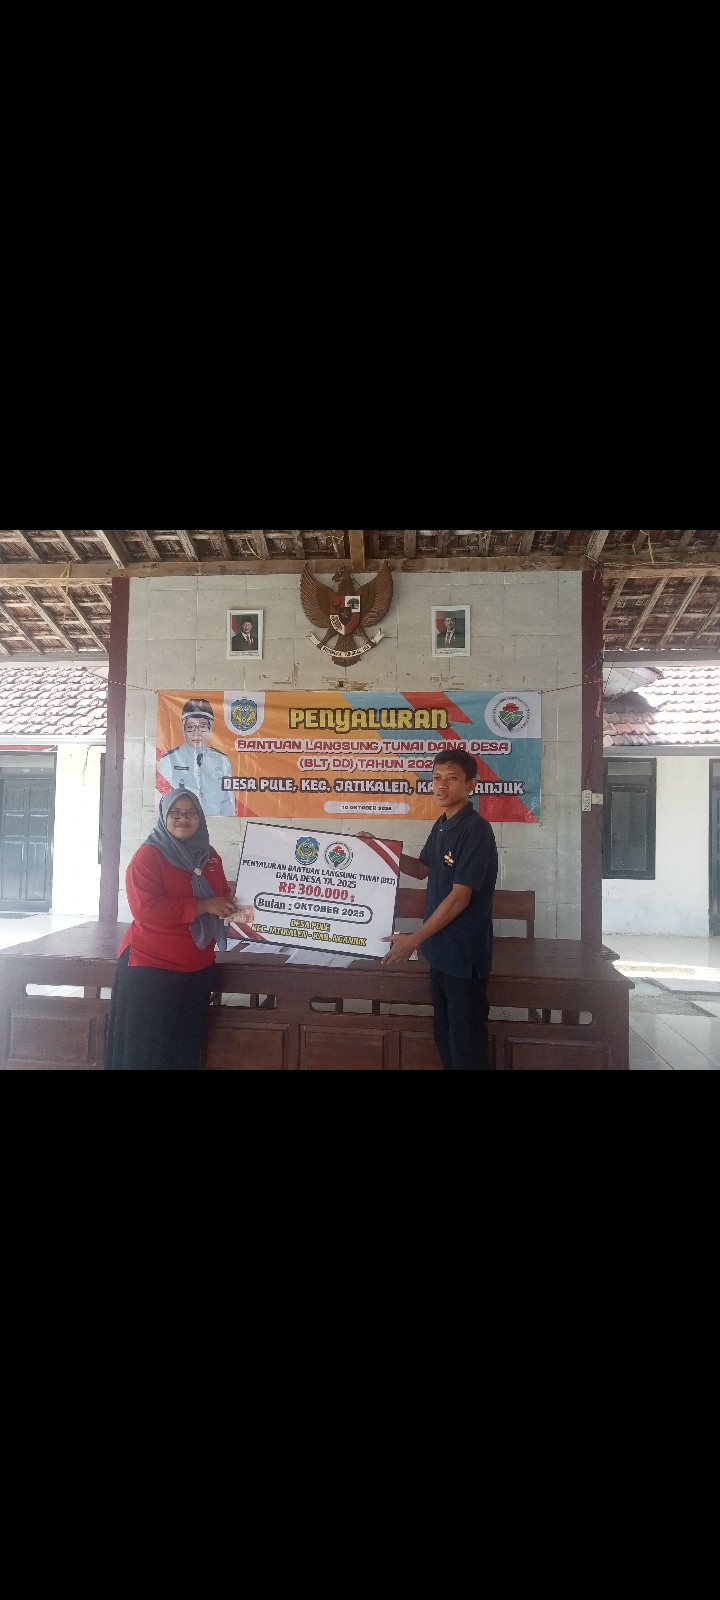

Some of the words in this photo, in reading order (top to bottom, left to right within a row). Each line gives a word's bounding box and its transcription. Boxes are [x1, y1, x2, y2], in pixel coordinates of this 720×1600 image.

[289, 708, 448, 733] PENYALURAN
[237, 740, 301, 750] BANTUAN
[305, 740, 378, 751] LANGSUNG
[382, 741, 423, 751] TUNAI
[427, 741, 467, 751] DANA
[470, 742, 509, 752] DESA
[299, 758, 328, 769] (BLT
[332, 758, 354, 769] DD)
[358, 759, 404, 769] TAHUN
[407, 760, 434, 769] 202
[223, 778, 256, 791] DESA
[260, 778, 297, 792] PULE,
[301, 779, 331, 792] KEC.
[335, 779, 413, 794] JATIKALEN,
[242, 859, 287, 871] PENYALURAN
[288, 865, 320, 875] BANTUAN
[321, 869, 357, 880] LANGSUNG
[359, 873, 379, 883] TUNAI
[380, 876, 396, 886] (BLT)
[275, 871, 299, 882] DANA
[300, 875, 321, 885] DESA
[323, 877, 335, 886] TA.
[337, 879, 357, 888] 2025
[298, 884, 348, 901] 300.000
[257, 897, 286, 910] Bulan
[294, 902, 339, 915] OKTOBER
[341, 908, 365, 918] 2025
[290, 919, 310, 929] DESA
[311, 921, 331, 932] PULE
[251, 924, 268, 934] KEC.
[268, 925, 308, 939] JATIKALEN
[312, 932, 331, 942] KAB.
[332, 935, 367, 947] NGANJUK
